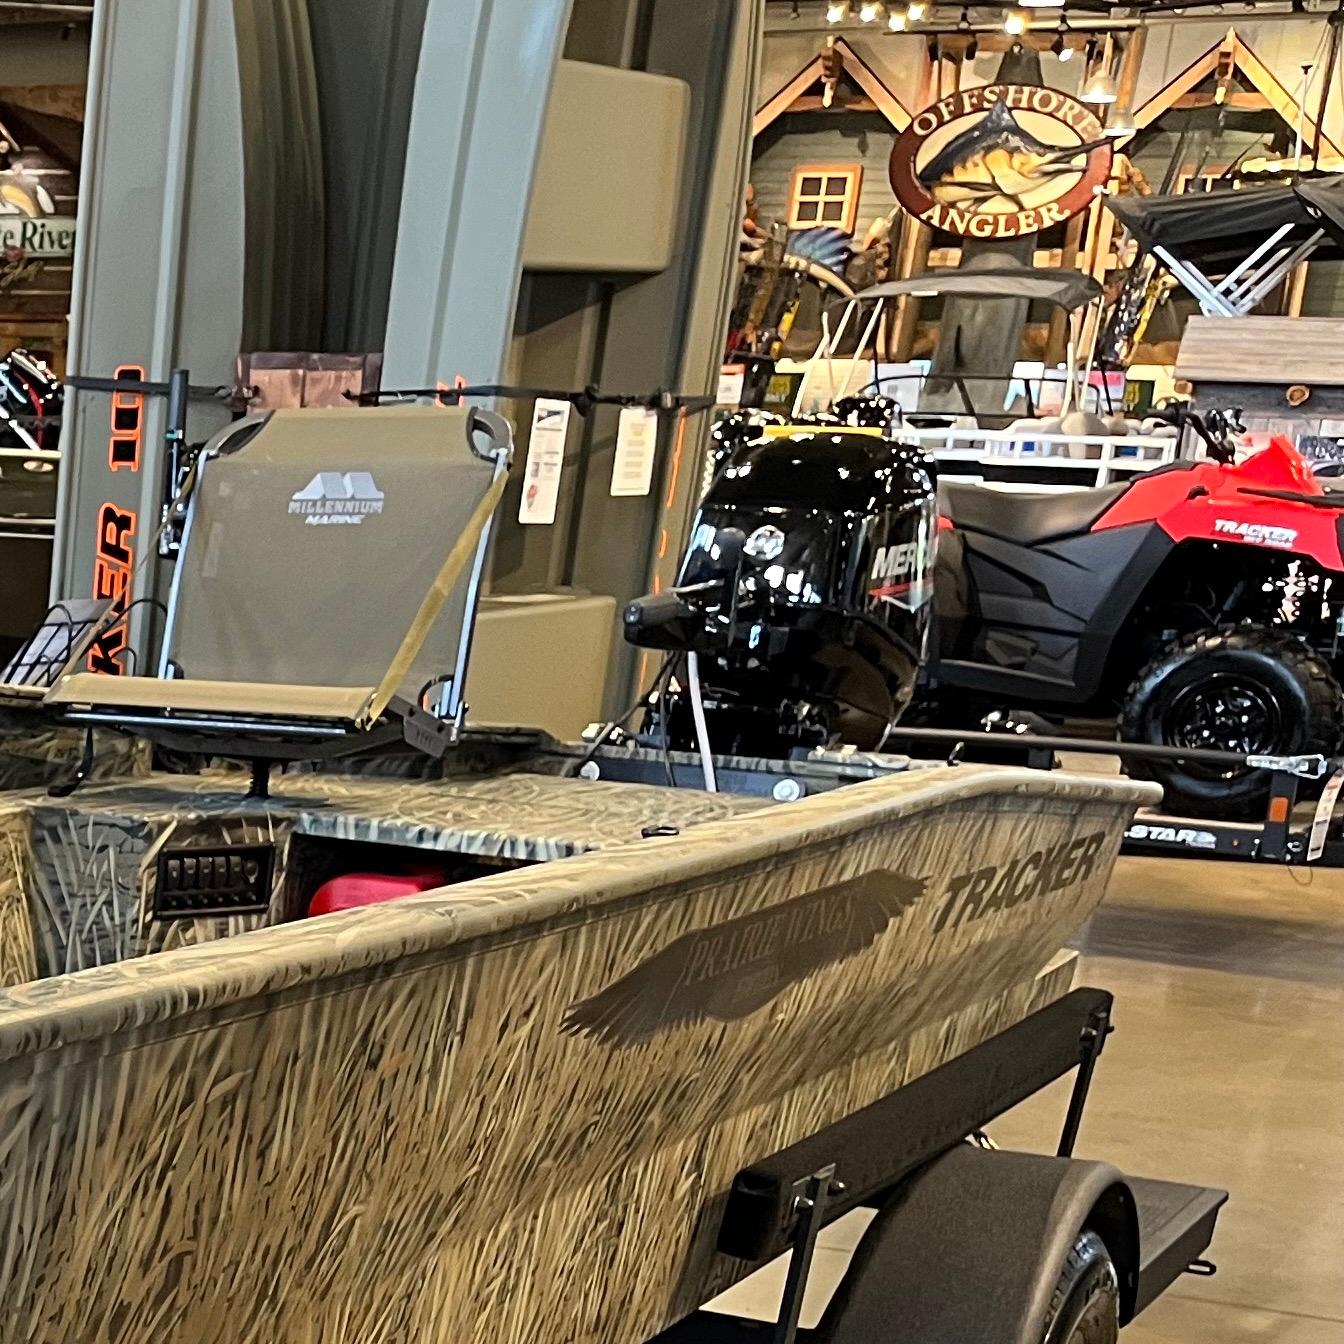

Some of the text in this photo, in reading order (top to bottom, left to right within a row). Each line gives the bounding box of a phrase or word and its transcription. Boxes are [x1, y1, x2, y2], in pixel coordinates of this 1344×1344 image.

[913, 86, 1104, 144] OFFSHORE
[920, 203, 1071, 238] ANGLER
[287, 500, 385, 514] MILLENNIUM
[1214, 519, 1298, 542] TRACKER
[933, 831, 1106, 935] TRACKER
